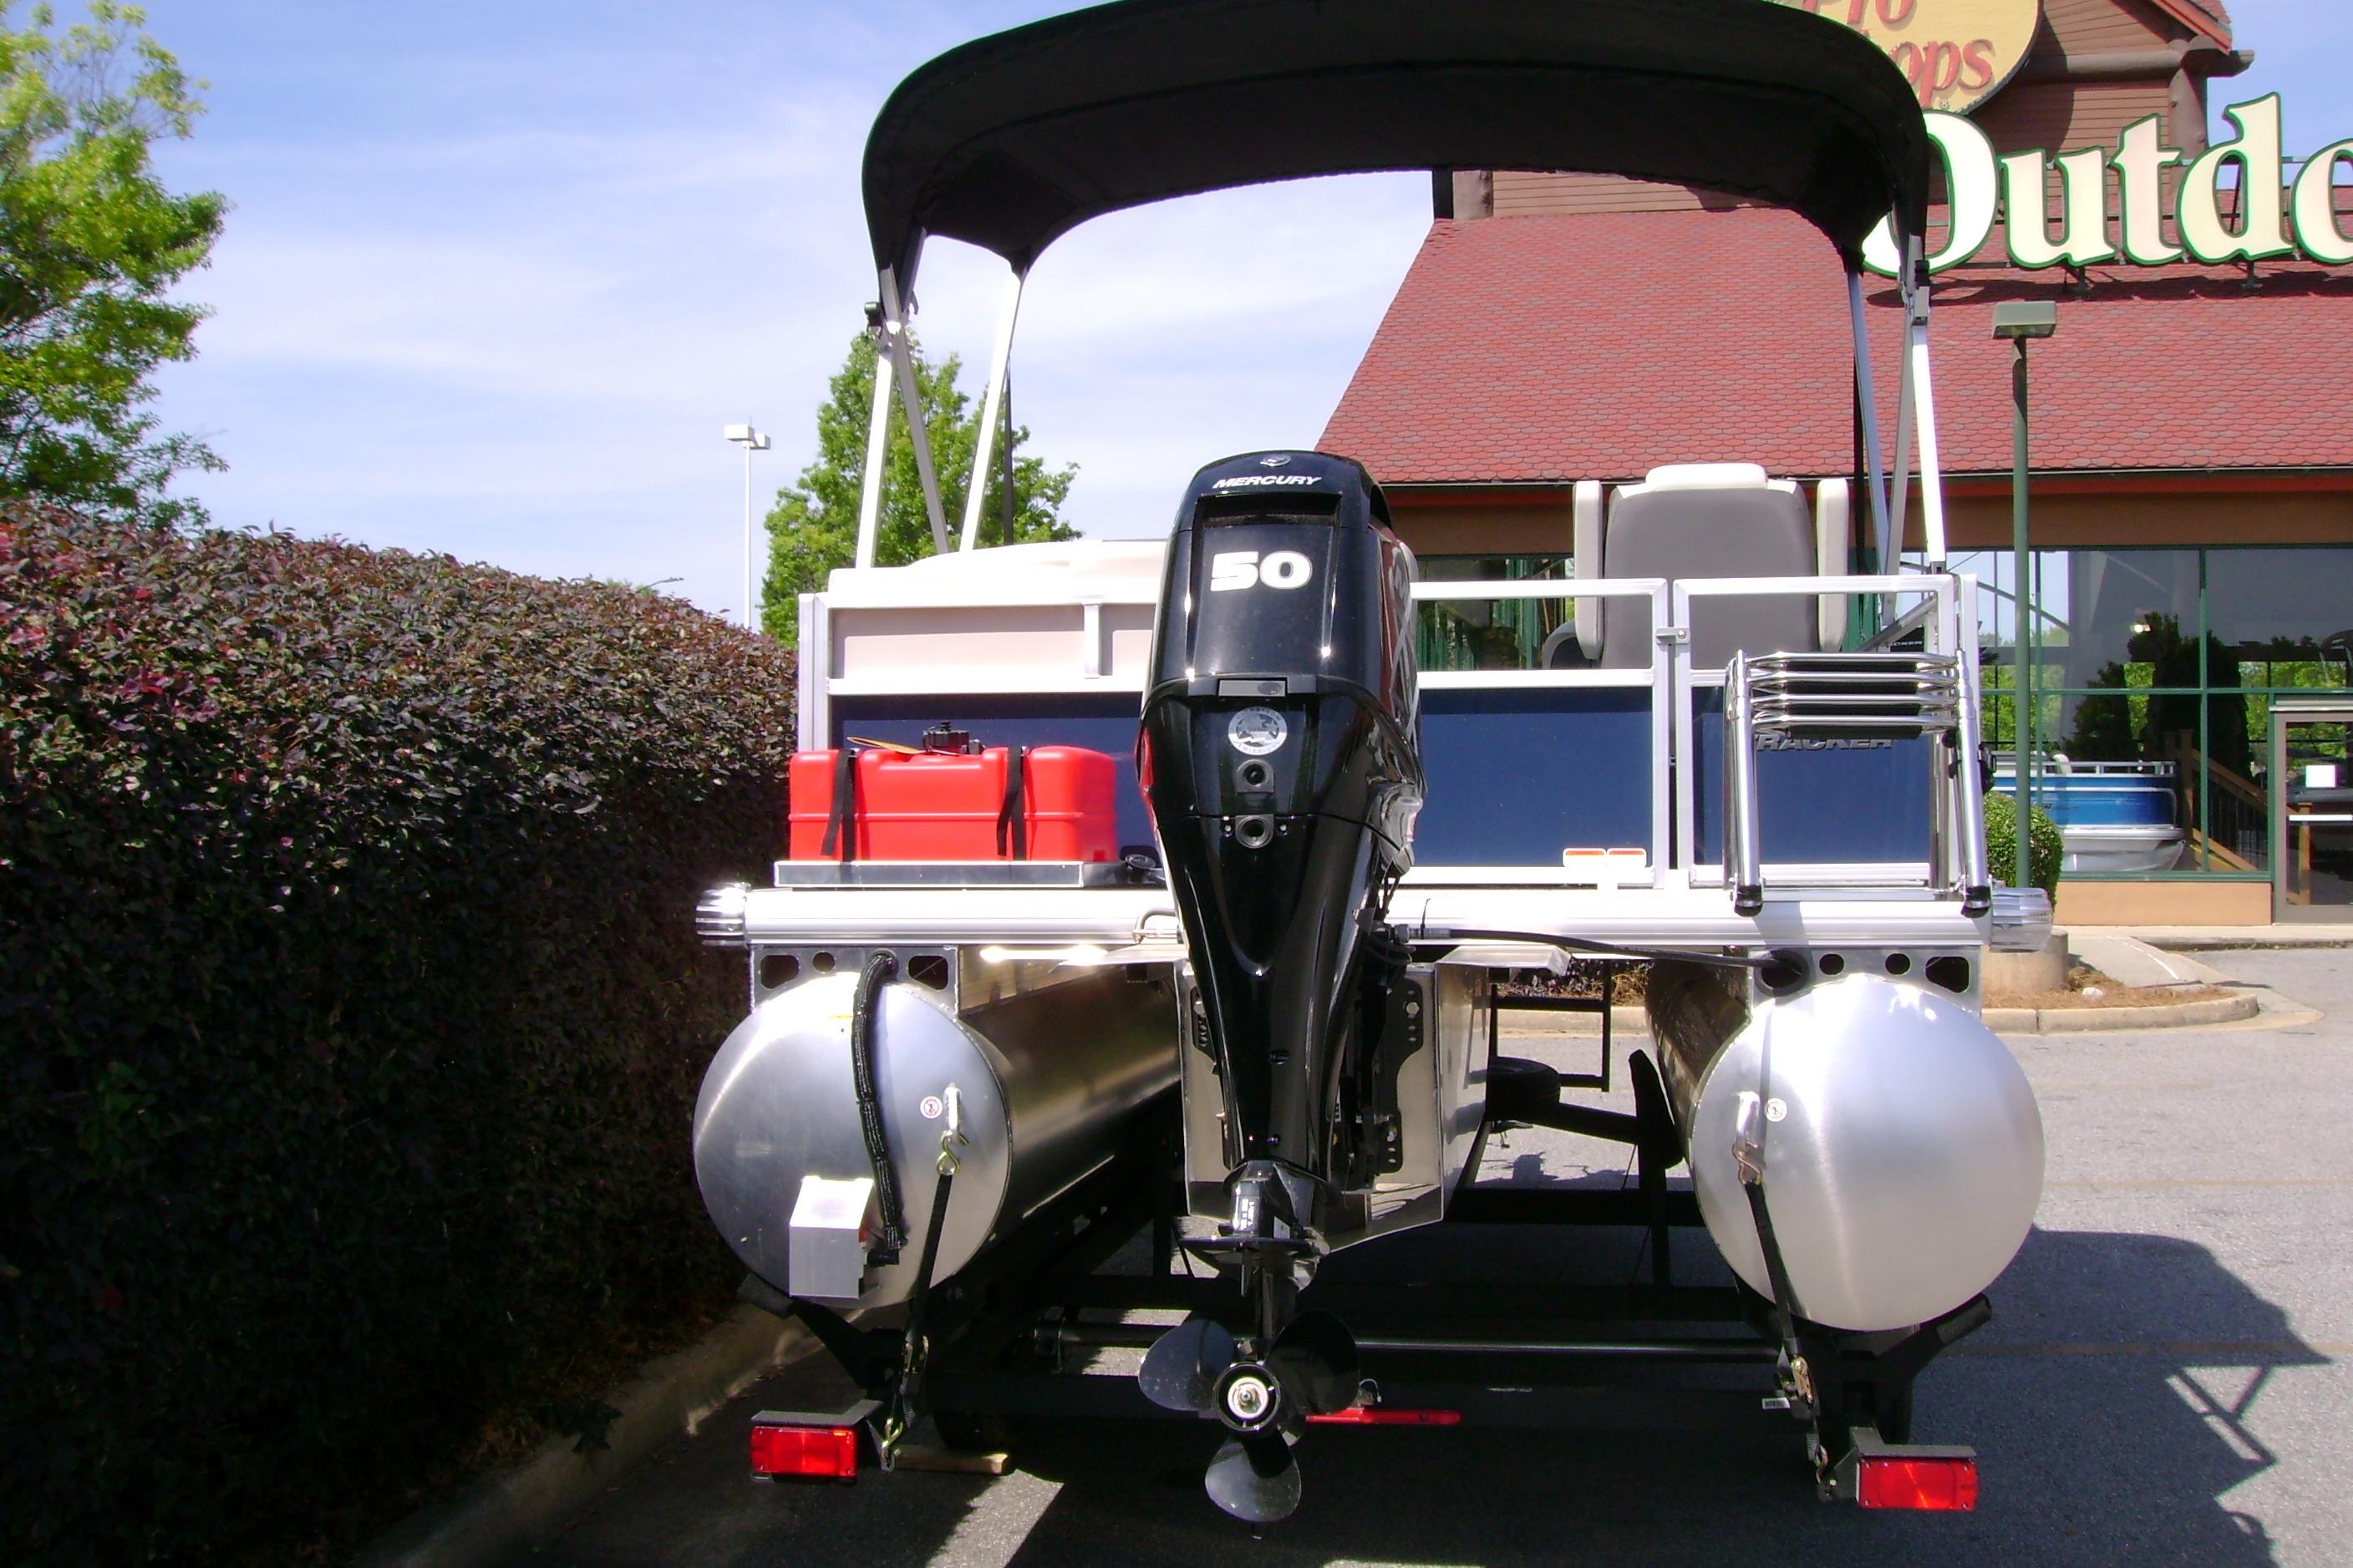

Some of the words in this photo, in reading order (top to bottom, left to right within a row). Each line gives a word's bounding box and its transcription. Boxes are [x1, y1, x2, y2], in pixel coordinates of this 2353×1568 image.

[1212, 475, 1323, 489] MERCURY
[1211, 551, 1314, 592] 50
[1755, 733, 1893, 751] RACKER
